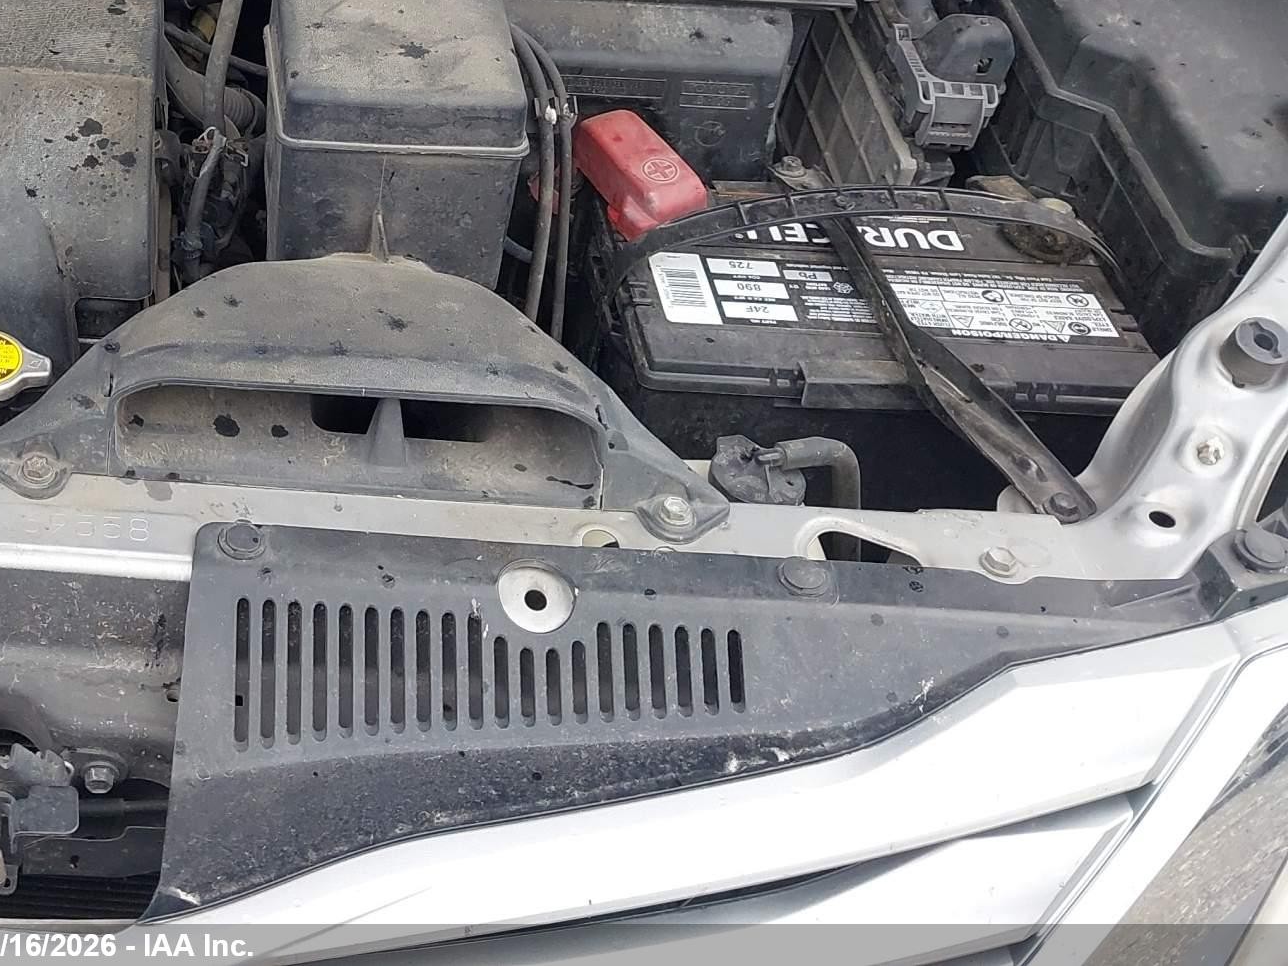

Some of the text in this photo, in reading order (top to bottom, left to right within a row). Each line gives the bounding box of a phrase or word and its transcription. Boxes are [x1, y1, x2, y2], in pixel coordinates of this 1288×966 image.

[729, 260, 754, 270] 725
[798, 271, 818, 280] Pb
[736, 282, 762, 291] 890
[745, 305, 770, 314] 24F
